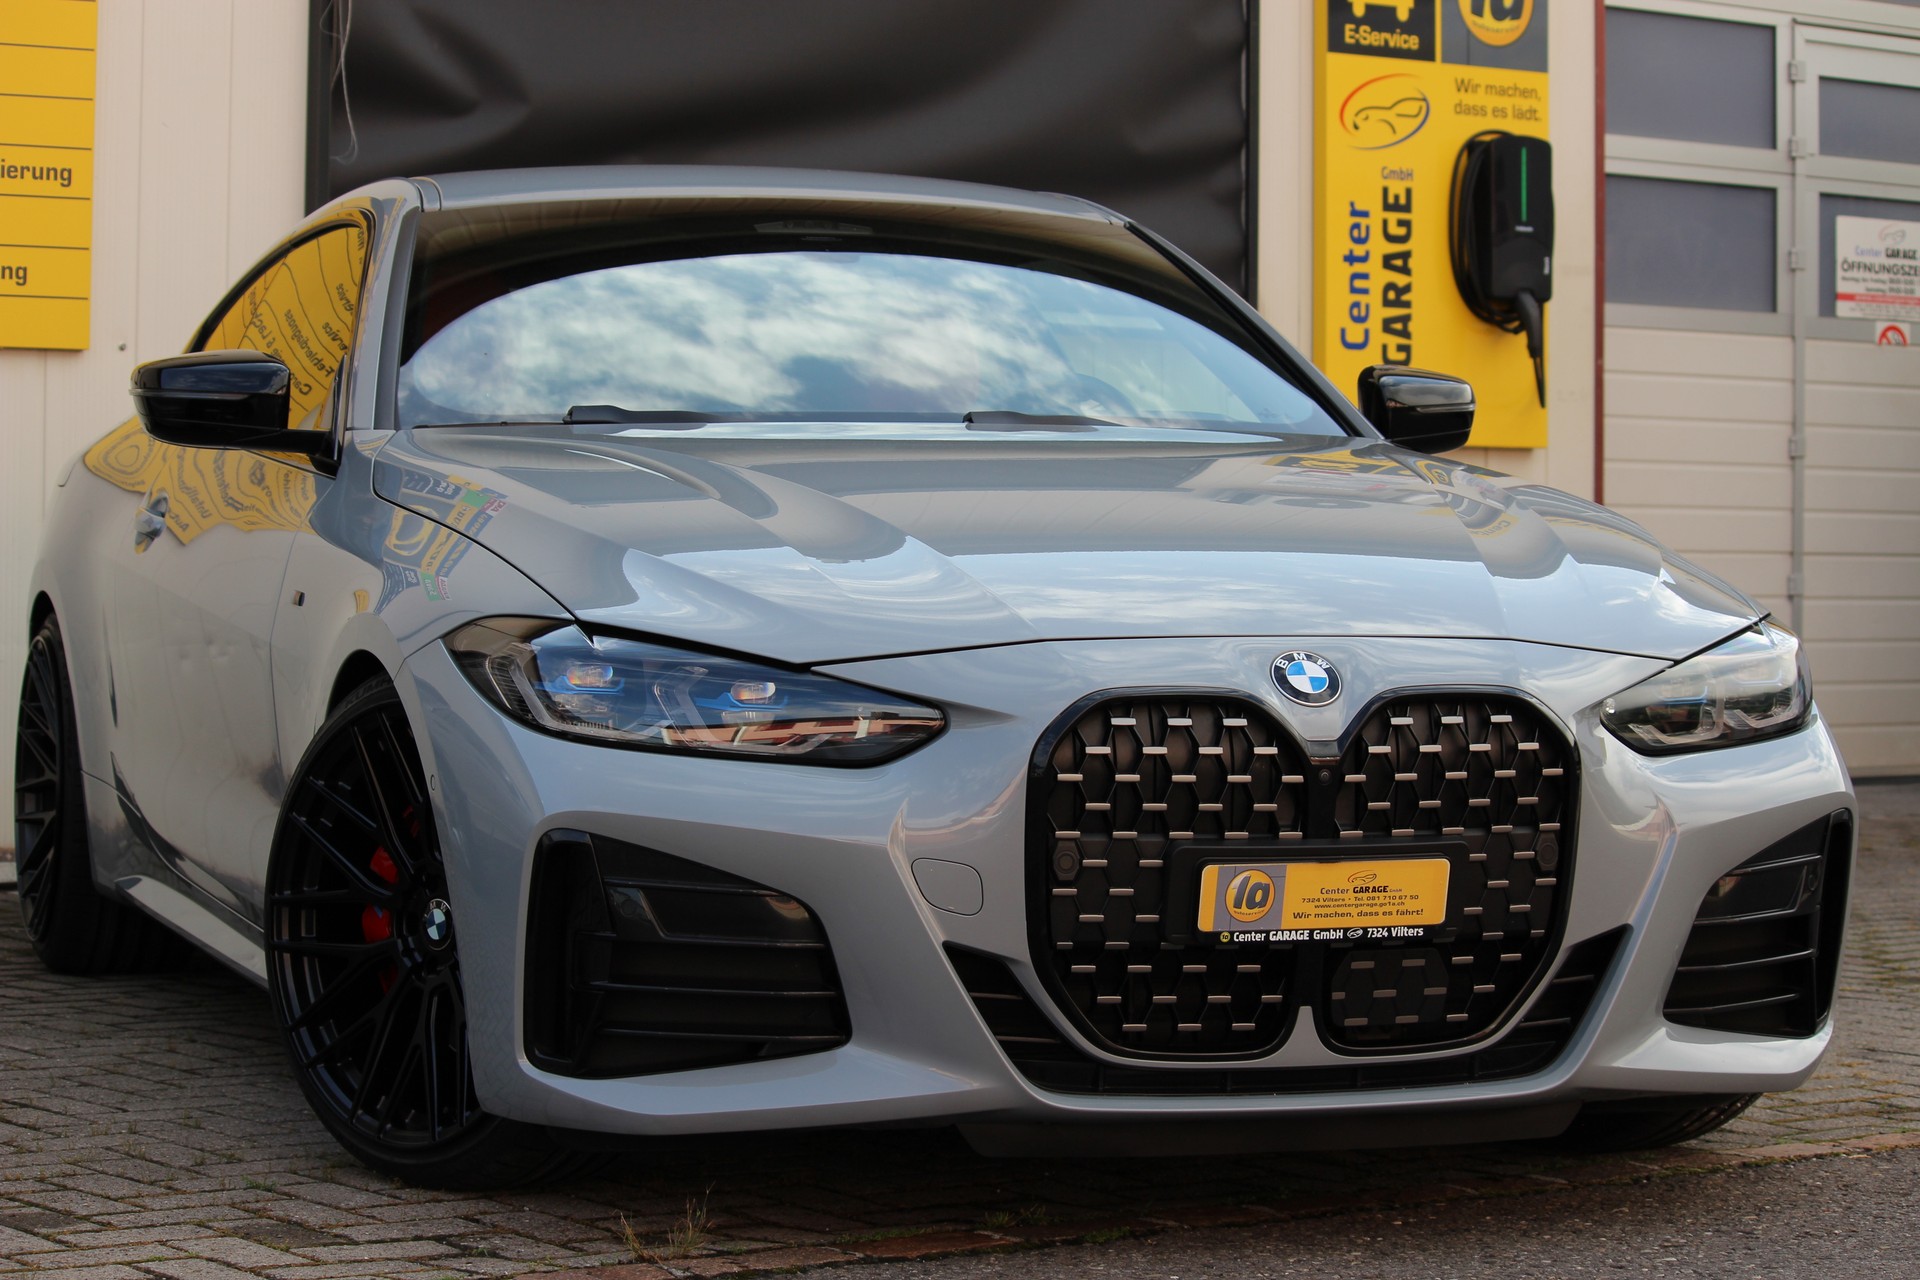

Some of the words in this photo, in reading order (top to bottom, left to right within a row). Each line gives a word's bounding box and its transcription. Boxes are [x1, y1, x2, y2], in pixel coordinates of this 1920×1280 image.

[1344, 23, 1419, 50] E-Service
[1455, 77, 1481, 94] Wir
[1485, 82, 1541, 101] machen,
[1454, 101, 1487, 117] dass
[1492, 106, 1508, 118] es
[1512, 104, 1542, 122] lädt.
[0, 158, 72, 187] ierung
[1381, 166, 1413, 181] GmbH
[1, 264, 28, 286] ng
[1340, 201, 1370, 350] Center
[1382, 186, 1412, 367] GARAGE
[1275, 652, 1330, 669] BMW
[1232, 875, 1271, 910] 1a
[1320, 887, 1350, 895] Center
[1353, 886, 1389, 894] GARAGE
[1293, 911, 1311, 919] Wir
[1314, 910, 1354, 918] machen,
[1357, 909, 1379, 917] dass
[1396, 908, 1423, 916] fährt!
[1233, 932, 1266, 941] Center
[1269, 930, 1310, 941] GARAGE
[1313, 928, 1343, 939] GmbH
[1367, 928, 1388, 938] 7324
[1391, 926, 1423, 937] Vilters
